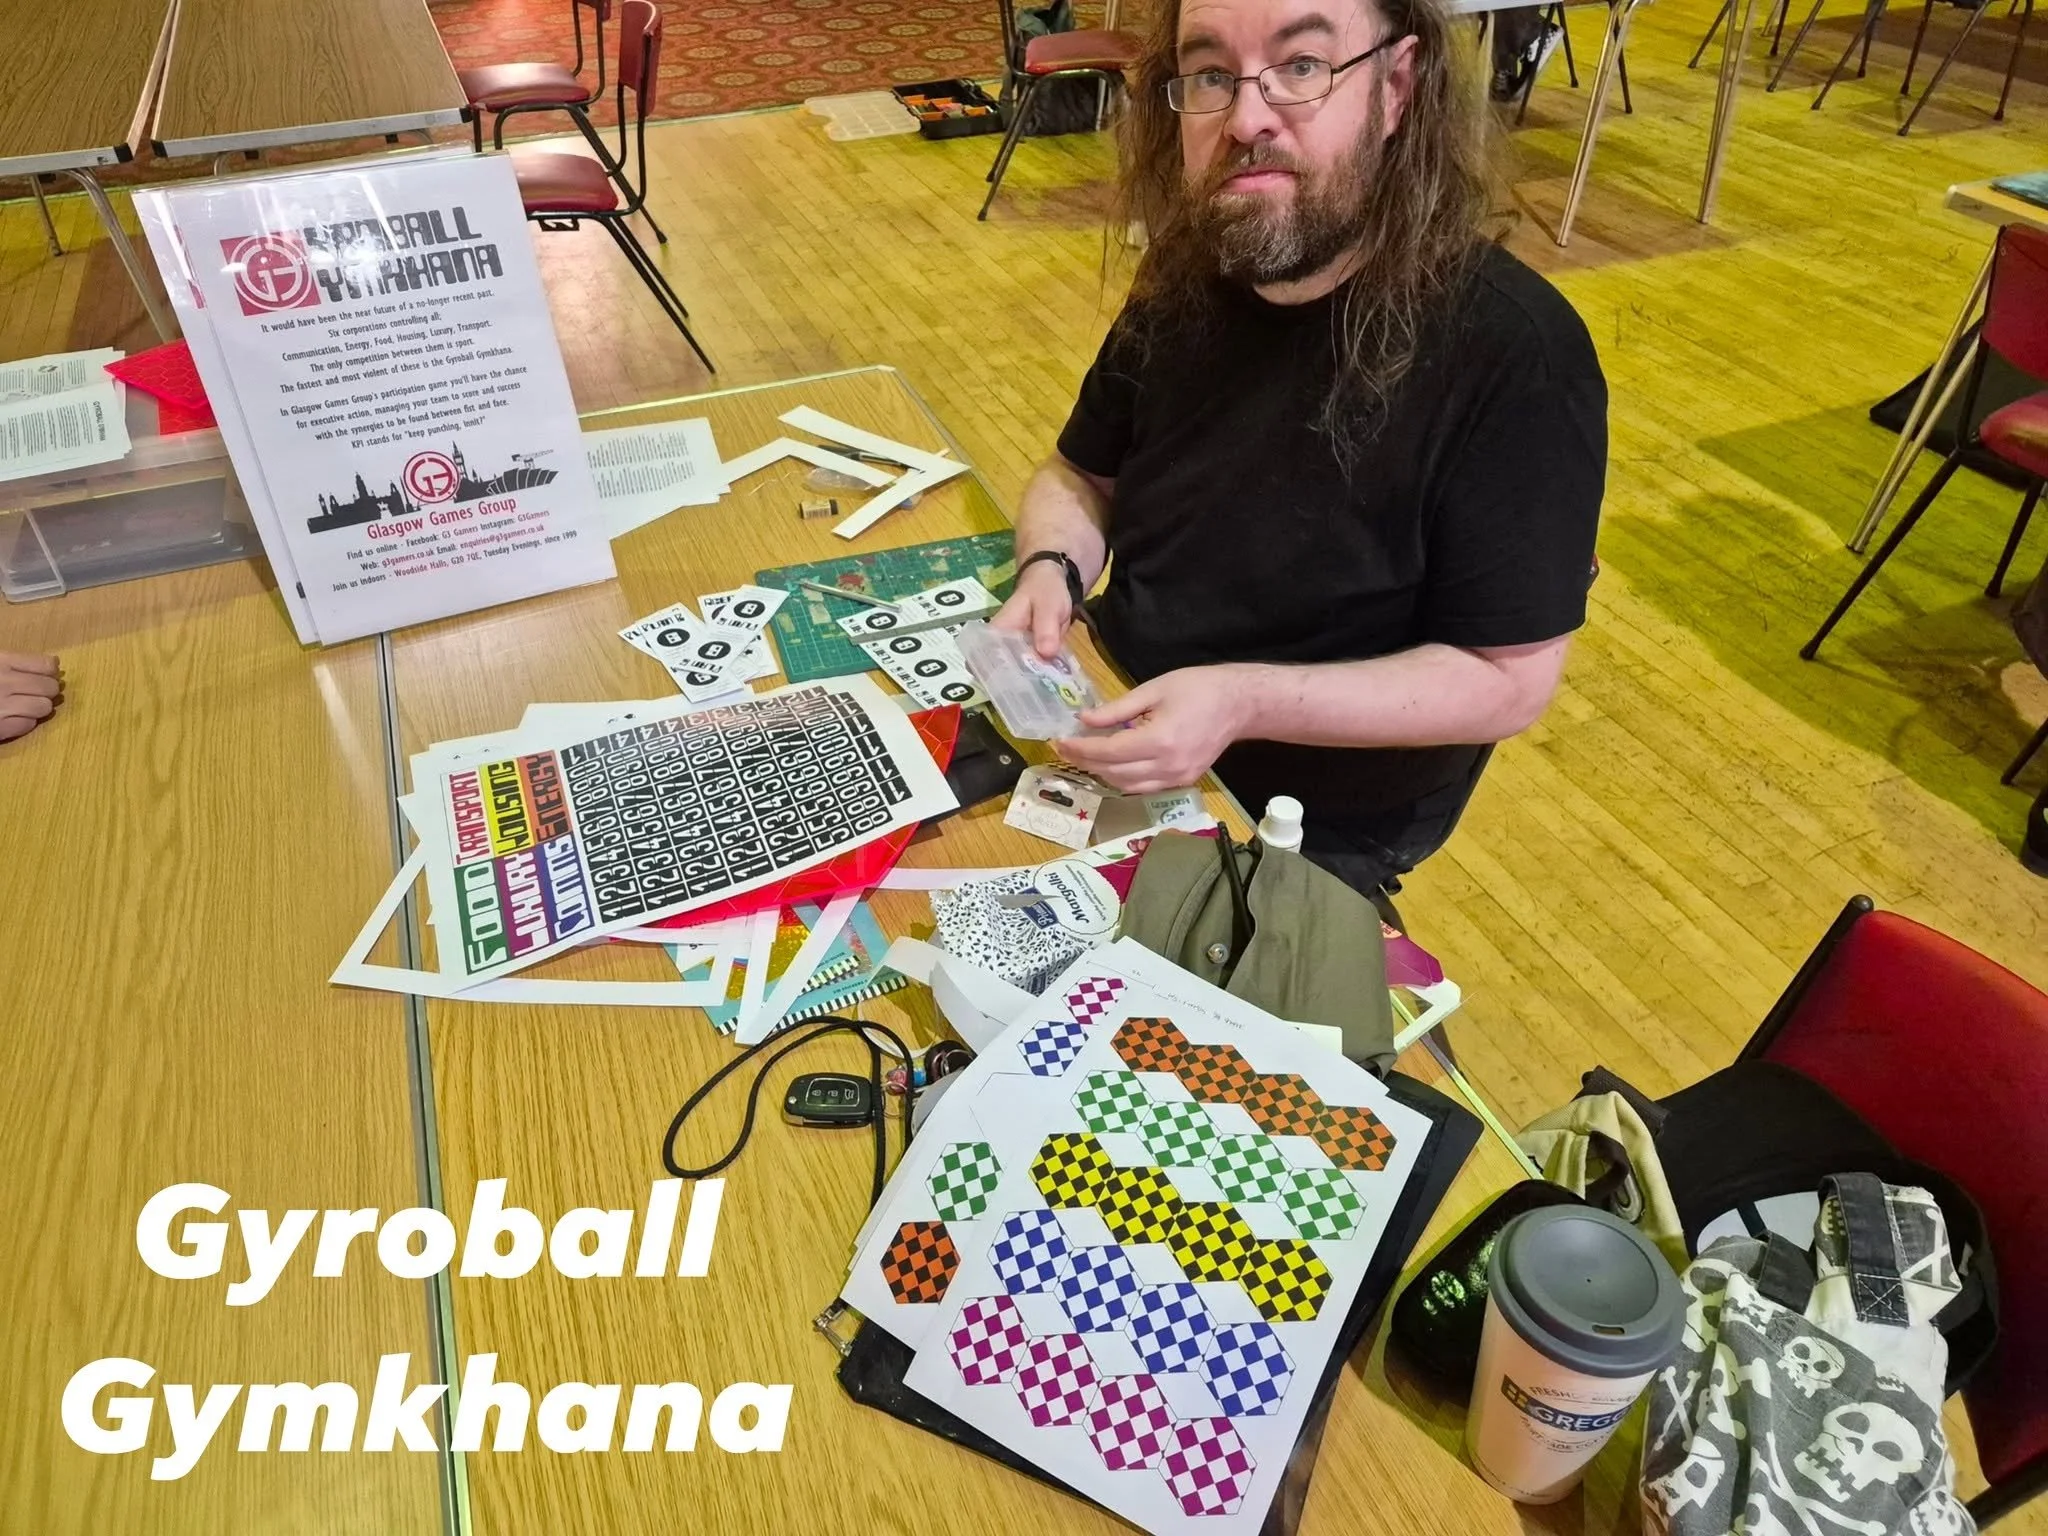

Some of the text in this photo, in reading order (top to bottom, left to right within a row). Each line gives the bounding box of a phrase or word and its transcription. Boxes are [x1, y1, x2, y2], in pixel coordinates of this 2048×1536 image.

[260, 324, 269, 333] It
[271, 320, 295, 331] would
[297, 318, 315, 328] have
[318, 314, 337, 324] been
[339, 311, 352, 321] the
[355, 309, 371, 318] near
[373, 304, 396, 316] future
[398, 301, 406, 311] of
[416, 296, 450, 309] no-longer
[452, 292, 474, 302] recent
[477, 289, 494, 299] past.
[328, 329, 340, 338] Six
[342, 321, 387, 336] corporations
[389, 315, 429, 329] controlling
[280, 384, 294, 394] The
[296, 379, 322, 391] fastest
[325, 376, 339, 385] and
[342, 373, 361, 383] most
[363, 367, 388, 379] violent
[391, 365, 398, 374] of
[401, 362, 420, 372] these
[422, 361, 429, 369] is
[431, 357, 443, 367] the
[445, 351, 474, 365] Gyroball
[310, 363, 324, 372] The
[327, 360, 343, 370] only
[345, 352, 389, 367] competition
[391, 346, 423, 359] between
[425, 343, 444, 353] them
[446, 341, 453, 349] is
[280, 366, 527, 416] In Glasgow Games Group's participation game you'll have the chance
[296, 382, 521, 429] for executive action, managing your team to score and success
[315, 430, 333, 441] with
[335, 428, 348, 437] the
[350, 421, 384, 435] synergies
[396, 417, 406, 425] be
[408, 412, 429, 423] found
[431, 407, 462, 420] between
[463, 404, 476, 413] fist
[478, 401, 491, 410] and
[493, 398, 509, 408] face.
[351, 439, 364, 449] KPI
[367, 435, 390, 447] stands
[391, 432, 403, 441] for
[427, 421, 461, 436] punching,
[347, 510, 550, 561] Find us online Facebook: G3 Gamers Instagram: G3Gamers
[367, 498, 517, 540] Glasgow Games Group
[332, 581, 348, 592] Join
[349, 580, 358, 588] us
[394, 565, 428, 577] Woodside
[430, 560, 449, 571] Halls,
[450, 555, 464, 565] G20
[483, 546, 510, 559] Tuesday
[511, 539, 542, 552] Evenings,
[544, 535, 561, 545] since
[562, 530, 577, 540] 1999
[360, 523, 545, 572] Web: g3gamers.co.uk Email: enquiries@g3gamers.co.uk
[449, 770, 490, 865] TRANSPORT
[464, 861, 508, 972] FOOD
[503, 851, 550, 957] LUXURY
